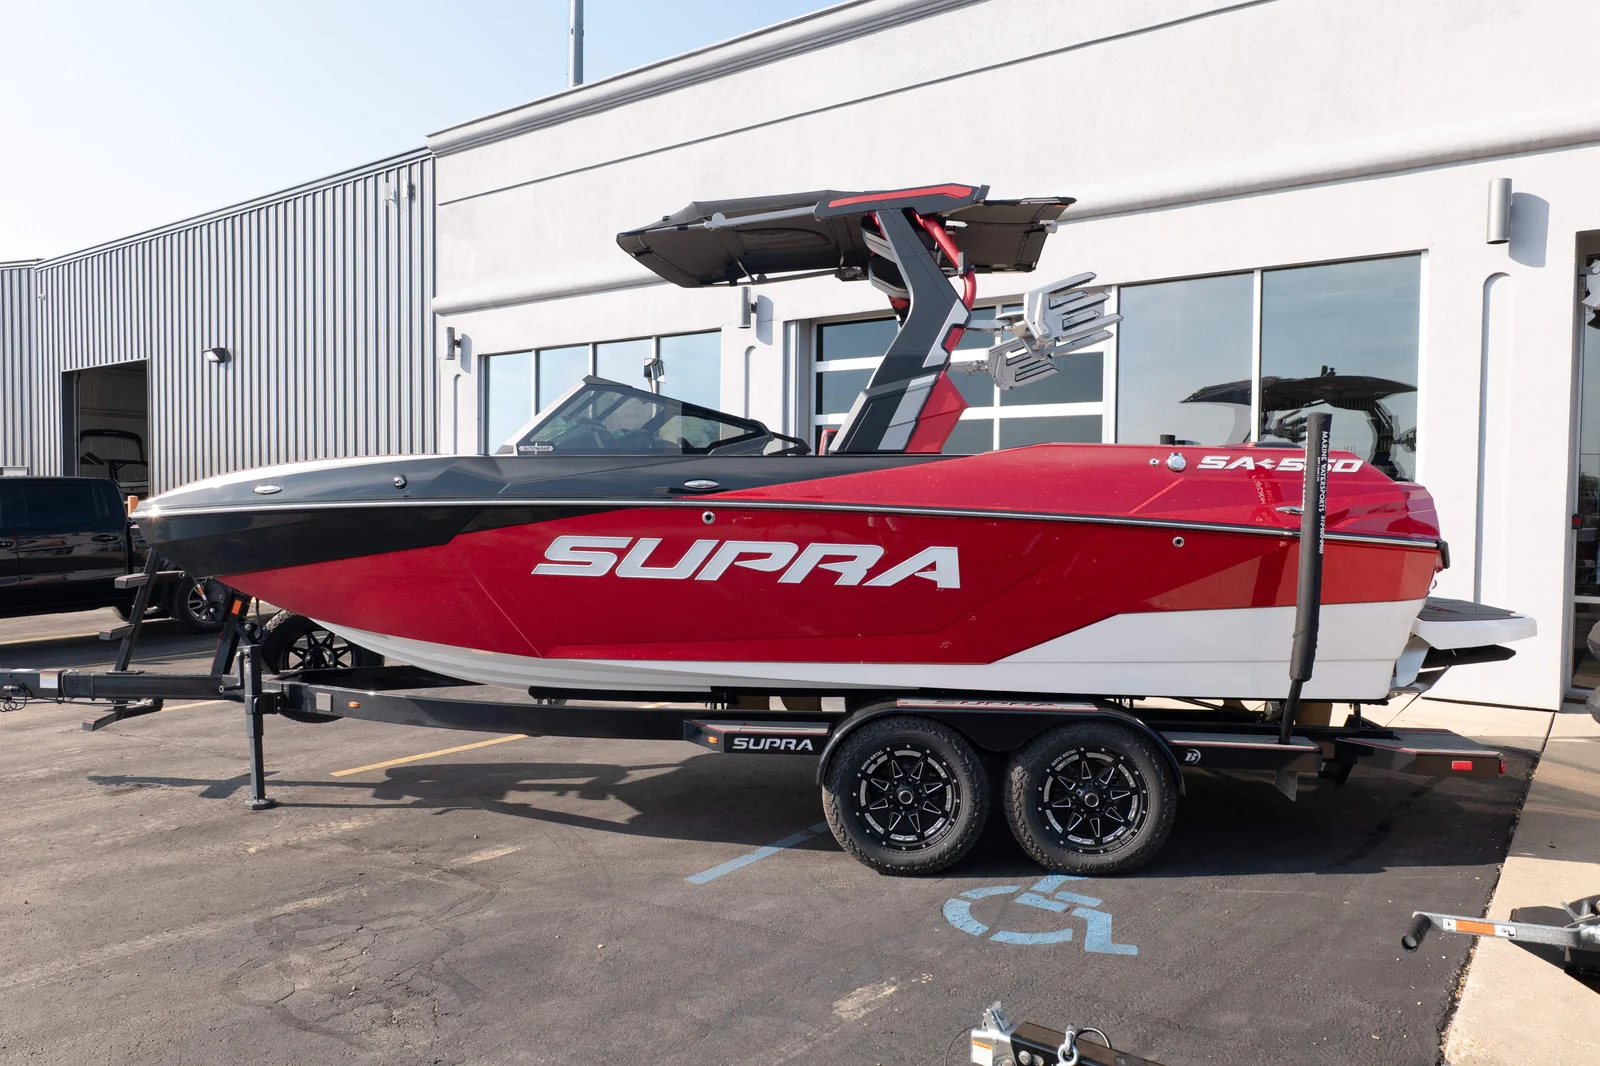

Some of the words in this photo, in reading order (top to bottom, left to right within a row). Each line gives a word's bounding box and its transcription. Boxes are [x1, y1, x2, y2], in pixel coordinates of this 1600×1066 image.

[1197, 455, 1256, 470] SA
[1319, 464, 1327, 512] WATERSPORTS
[531, 535, 961, 588] SUPRA
[732, 737, 814, 751] SUPRA
